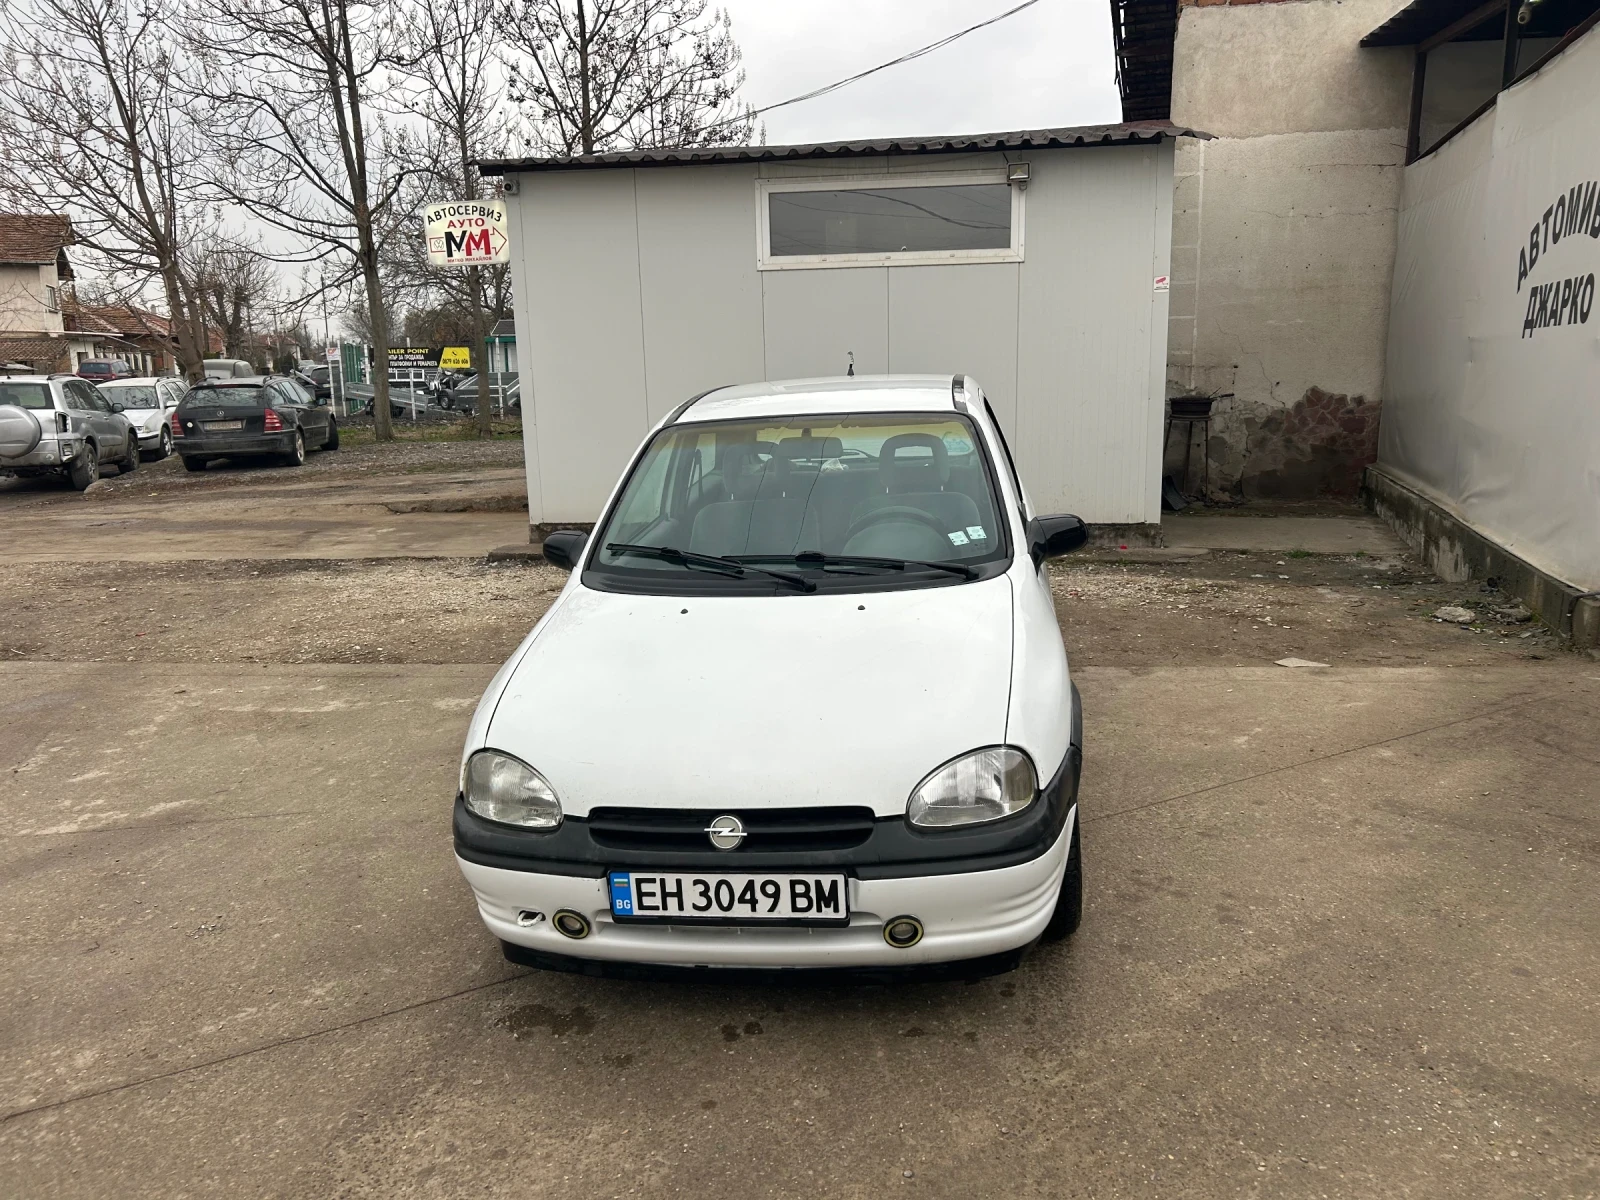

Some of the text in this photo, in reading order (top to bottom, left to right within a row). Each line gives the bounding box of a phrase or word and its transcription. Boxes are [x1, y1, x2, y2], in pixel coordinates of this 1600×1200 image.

[427, 205, 502, 226] АВТОСЕРВИЗ
[447, 217, 485, 229] АУТО
[1522, 273, 1595, 339] ДЖАРКО
[616, 899, 631, 909] BG
[635, 878, 840, 914] EH 3049 BM
